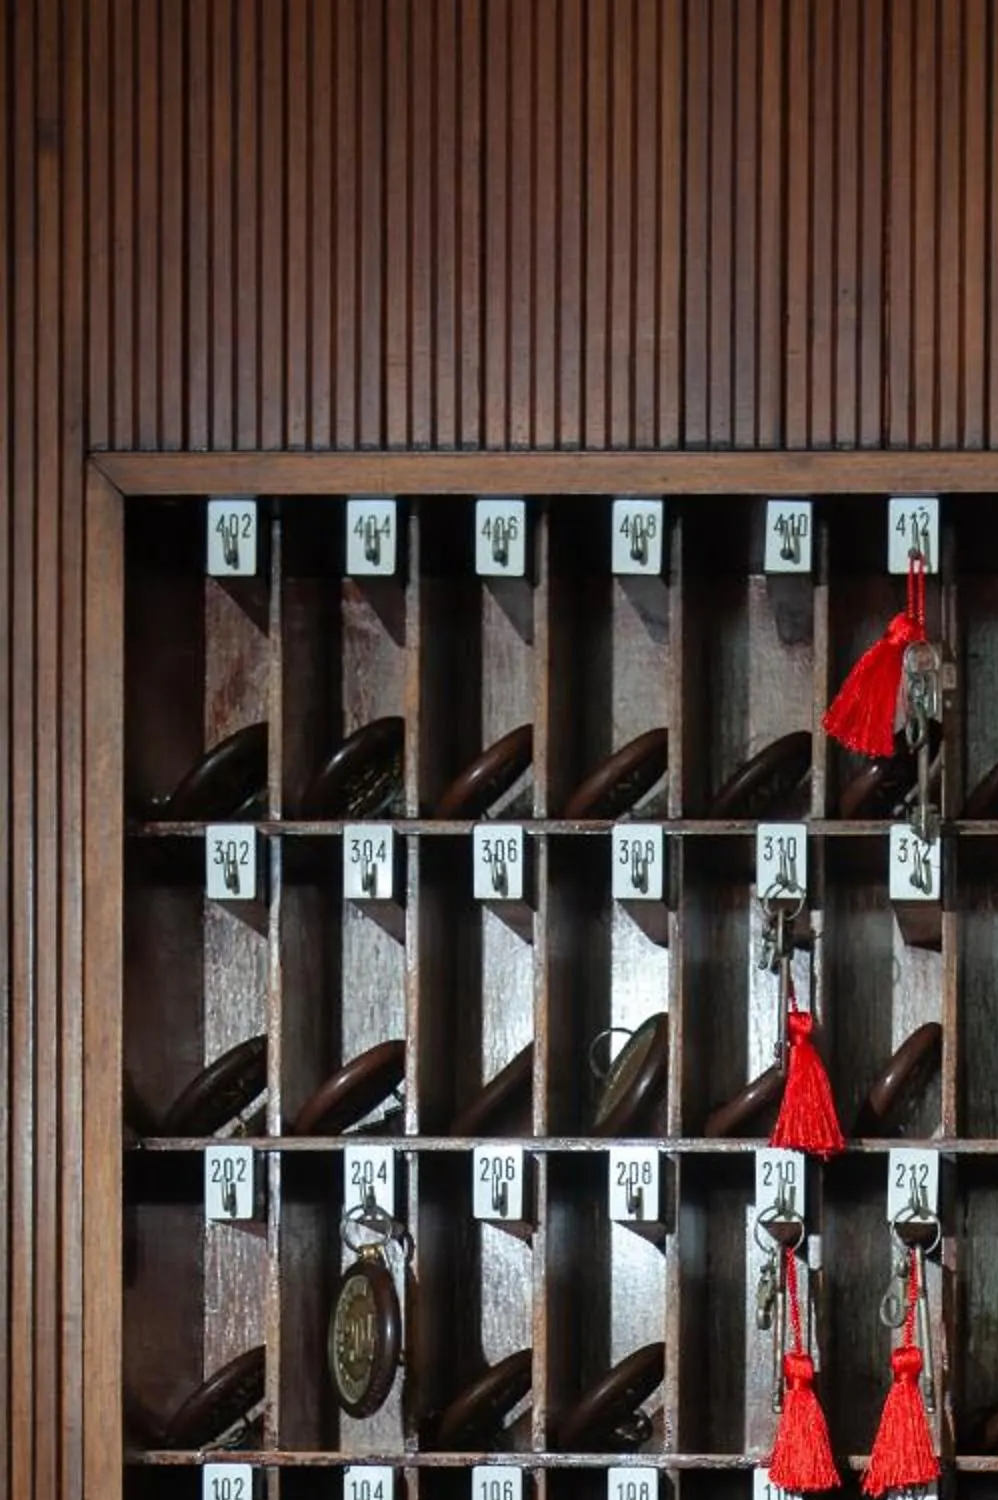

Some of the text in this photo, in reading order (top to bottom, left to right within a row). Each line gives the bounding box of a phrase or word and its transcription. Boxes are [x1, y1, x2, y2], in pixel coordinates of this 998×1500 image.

[216, 514, 252, 538] 402
[353, 515, 391, 538] 404
[481, 516, 518, 540] 406
[619, 514, 656, 538] 408
[774, 513, 808, 537] 410
[895, 512, 930, 537] 412
[213, 841, 249, 865] 302
[350, 840, 386, 863] 304
[481, 839, 517, 863] 306
[763, 837, 797, 861] 310
[898, 838, 932, 863] 312
[211, 1159, 247, 1183] 202
[352, 1161, 387, 1184] 204
[480, 1157, 515, 1181] 206
[617, 1161, 652, 1185] 208
[763, 1162, 795, 1186] 210
[895, 1163, 929, 1187] 212
